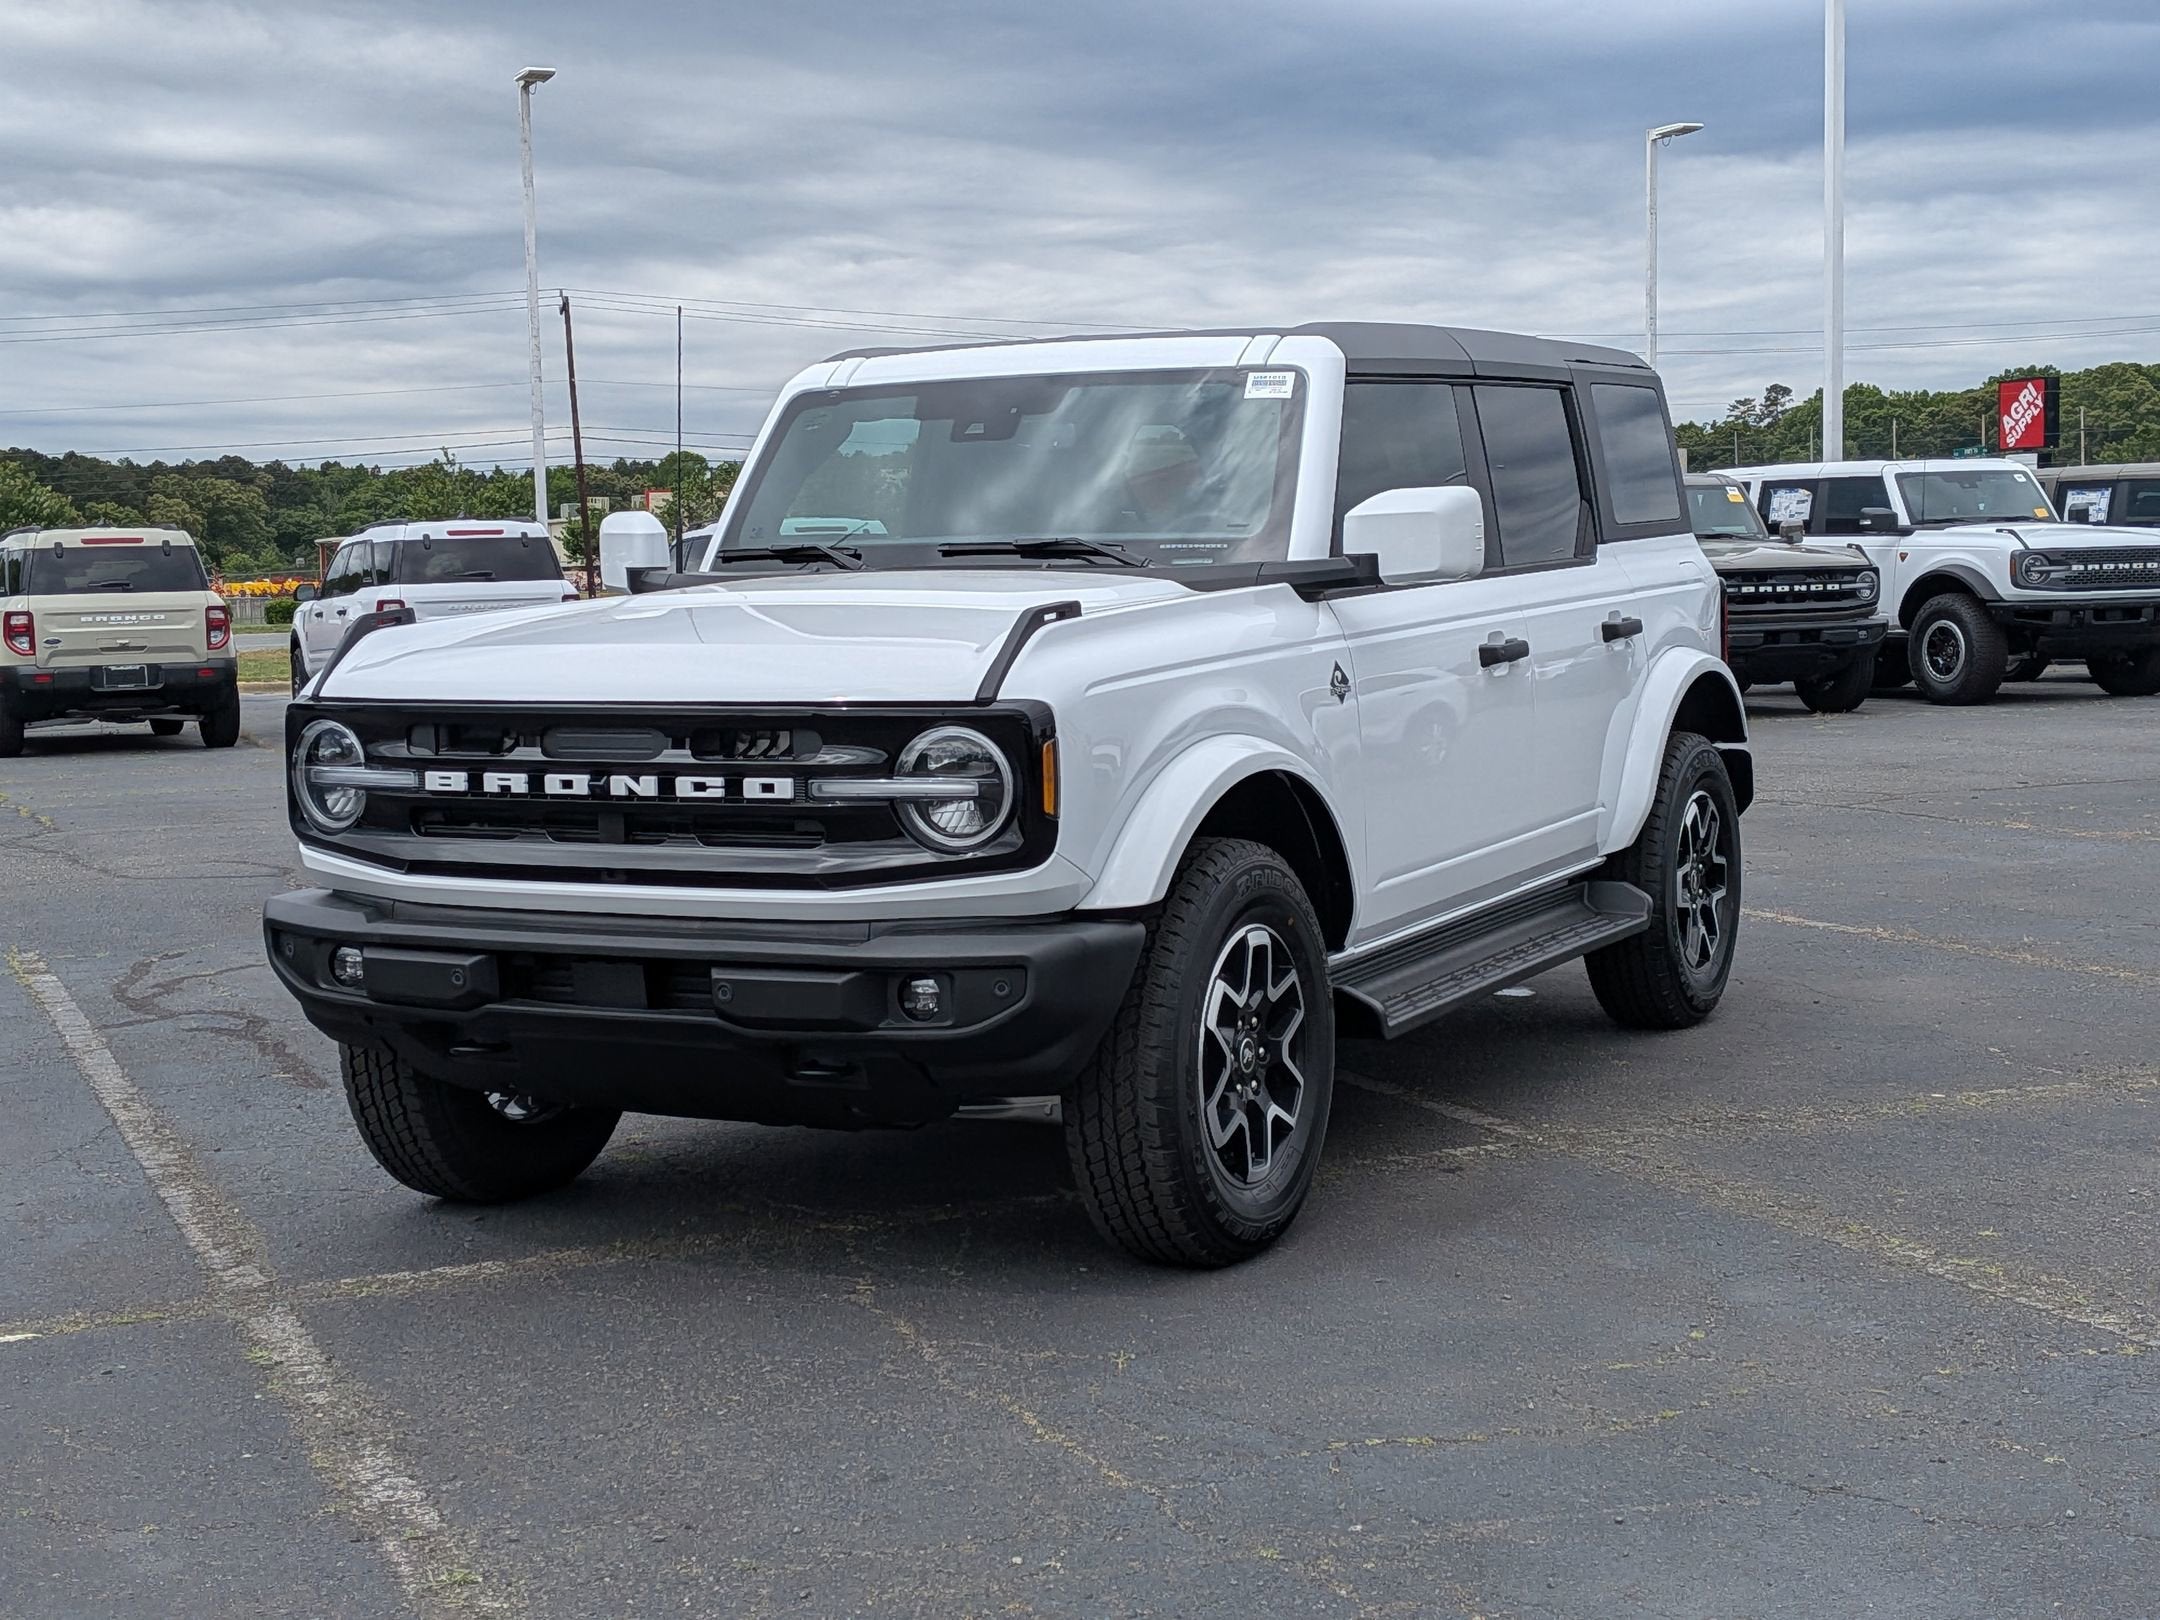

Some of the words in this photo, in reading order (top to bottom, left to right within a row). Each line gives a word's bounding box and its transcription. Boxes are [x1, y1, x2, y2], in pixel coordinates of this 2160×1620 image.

[2002, 381, 2038, 435] AGRI
[2006, 392, 2044, 448] SUPPLY
[2071, 562, 2159, 571] BRONCO
[1741, 583, 1840, 593] BRONCO
[80, 614, 165, 622] BRONCO
[424, 770, 794, 800] BRONCO
